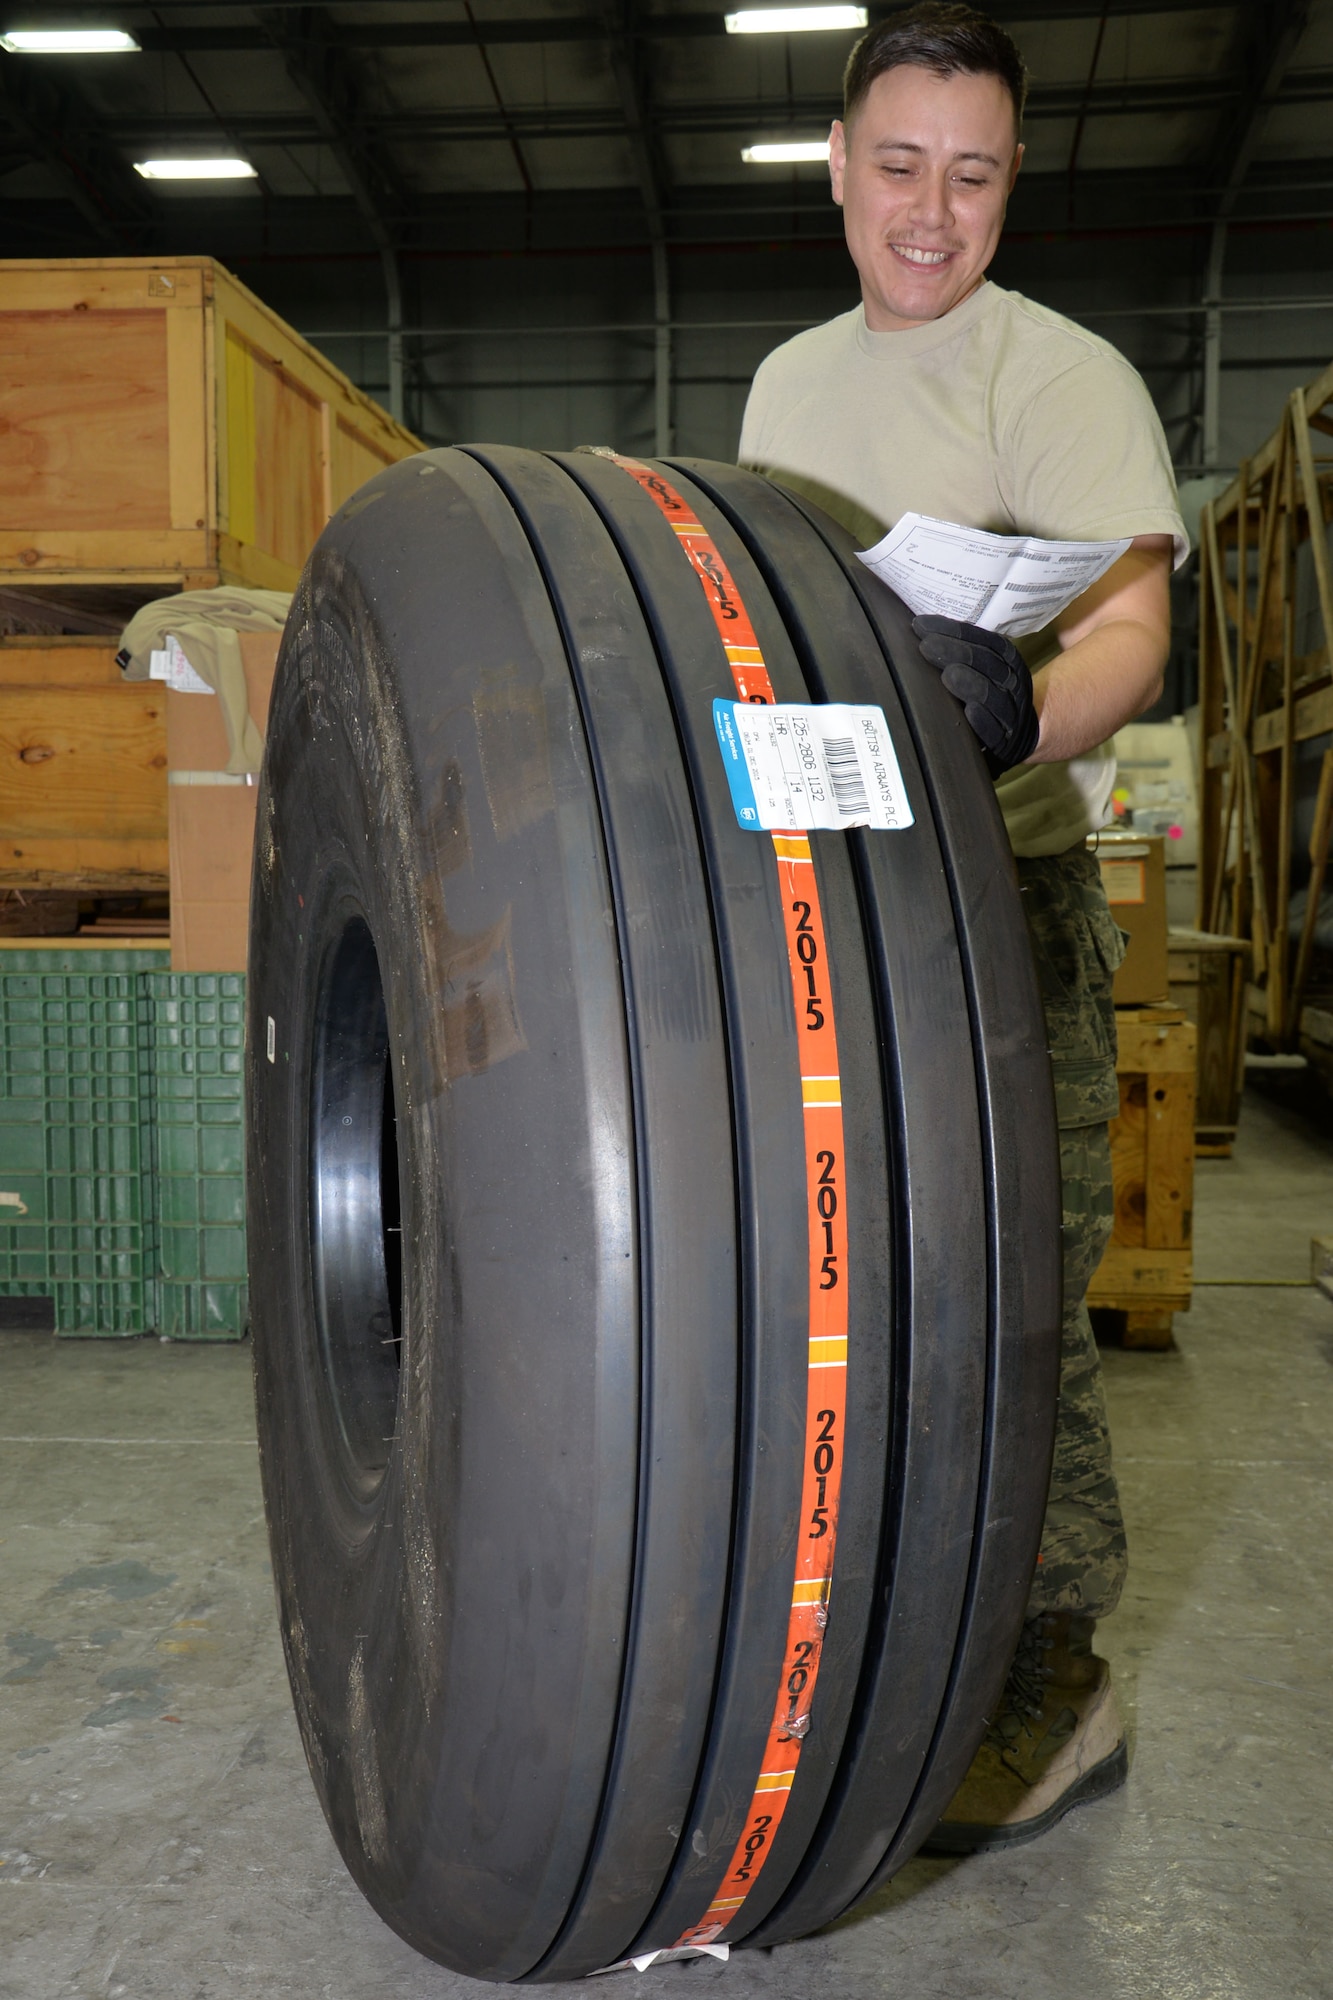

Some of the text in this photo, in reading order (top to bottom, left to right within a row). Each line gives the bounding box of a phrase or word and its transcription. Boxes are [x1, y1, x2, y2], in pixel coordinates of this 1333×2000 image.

[640, 475, 681, 510] 2015
[697, 552, 738, 619] 2015
[774, 717, 788, 735] LHR
[792, 717, 825, 801] 125-2806 1132
[790, 782, 803, 792] 14
[861, 720, 898, 825] BRITISH AIRWAYS PLC
[792, 901, 824, 1031] 2015
[816, 1150, 838, 1290] 2015
[808, 1409, 836, 1538] 2015
[731, 1815, 772, 1882] 2015
